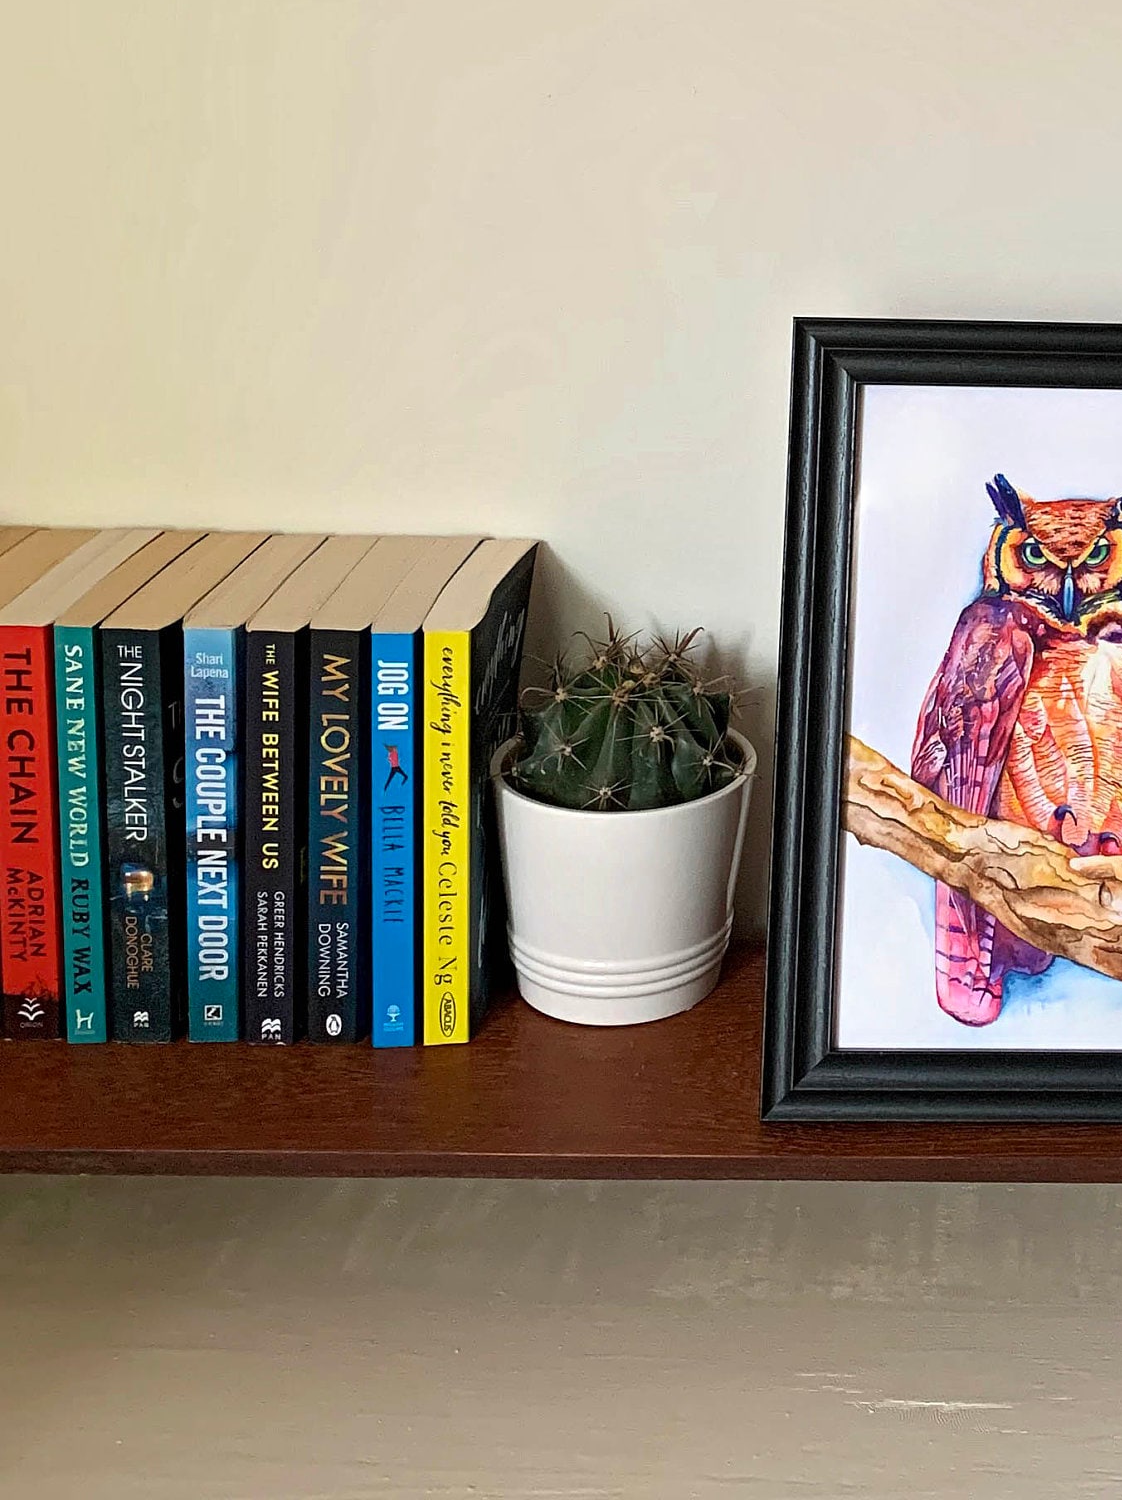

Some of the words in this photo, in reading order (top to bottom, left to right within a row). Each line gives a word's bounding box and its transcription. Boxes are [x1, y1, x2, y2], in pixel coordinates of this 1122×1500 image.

[3, 647, 34, 716] THE
[64, 644, 85, 711] SANE
[117, 645, 143, 659] THE
[190, 666, 229, 680] Lapena
[195, 652, 224, 665] Shari
[265, 643, 276, 665] THE
[320, 653, 352, 702] MY
[376, 659, 409, 696] JOG
[194, 694, 226, 741] THE
[261, 670, 280, 722] WIFE
[377, 703, 409, 731] ON
[430, 647, 462, 735] everything
[66, 718, 87, 779] NEW
[319, 713, 352, 824] LOVELY
[438, 749, 453, 795] never
[7, 729, 39, 844] CHAIN
[195, 747, 227, 843] COUPLE
[261, 733, 280, 832] BETWEEN
[68, 786, 90, 867] WORLD
[379, 805, 406, 852] BELLA
[432, 829, 453, 856] you
[438, 799, 460, 828] told
[197, 850, 228, 910] NEXT
[261, 842, 280, 870] US
[319, 831, 350, 906] WIFE
[6, 866, 28, 963] McKINTY
[27, 871, 47, 958] ADRIAN
[71, 876, 92, 939] RUBY
[257, 891, 268, 931] SARAH
[273, 891, 285, 929] GREER
[438, 862, 458, 946] Celeste
[72, 946, 93, 995] WAX
[125, 916, 140, 989] DONOGHUE
[140, 932, 154, 973] CLARE
[198, 915, 229, 982] DOOR
[256, 935, 268, 998] PEKKANEN
[273, 932, 285, 998] HENDRICKS
[318, 923, 332, 997] DOWNING
[336, 921, 349, 999] SAMANTHA
[434, 956, 458, 986] Ng
[261, 1033, 282, 1041] PAN
